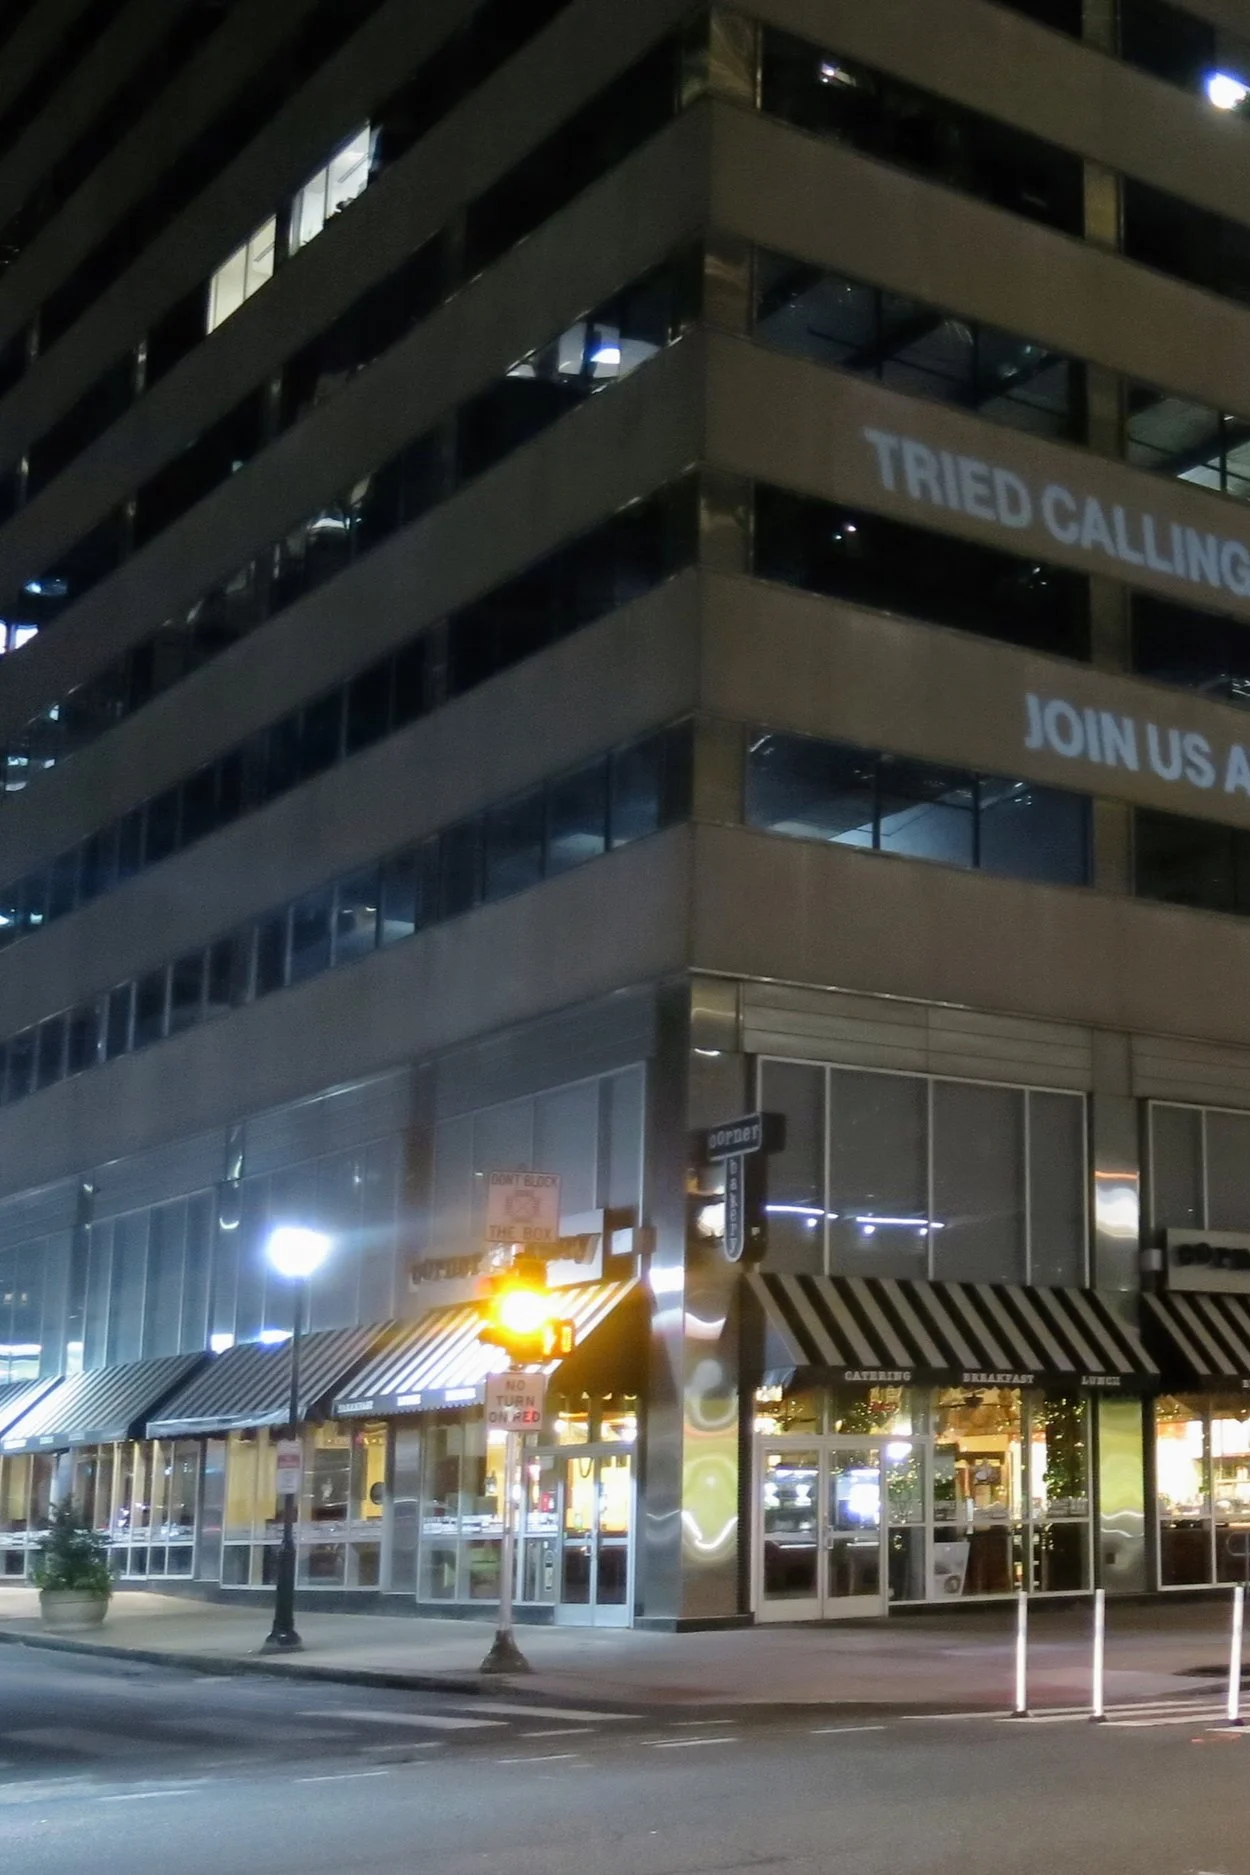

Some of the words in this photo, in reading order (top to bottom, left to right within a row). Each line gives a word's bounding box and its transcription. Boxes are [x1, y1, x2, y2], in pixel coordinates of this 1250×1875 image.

[863, 427, 1032, 529] TRIED
[1024, 692, 1139, 773] JOIN
[1144, 723, 1218, 789] US
[524, 1173, 557, 1188] BLOCK
[490, 1225, 516, 1241] THE
[523, 1226, 553, 1242] BOX
[506, 1379, 526, 1391] NO
[844, 1370, 912, 1382] CATERING
[962, 1372, 1035, 1385] BREAKFAST
[1081, 1375, 1121, 1388] LUNCH
[496, 1395, 536, 1406] TURN
[489, 1411, 507, 1424] ON
[512, 1410, 542, 1424] RED
